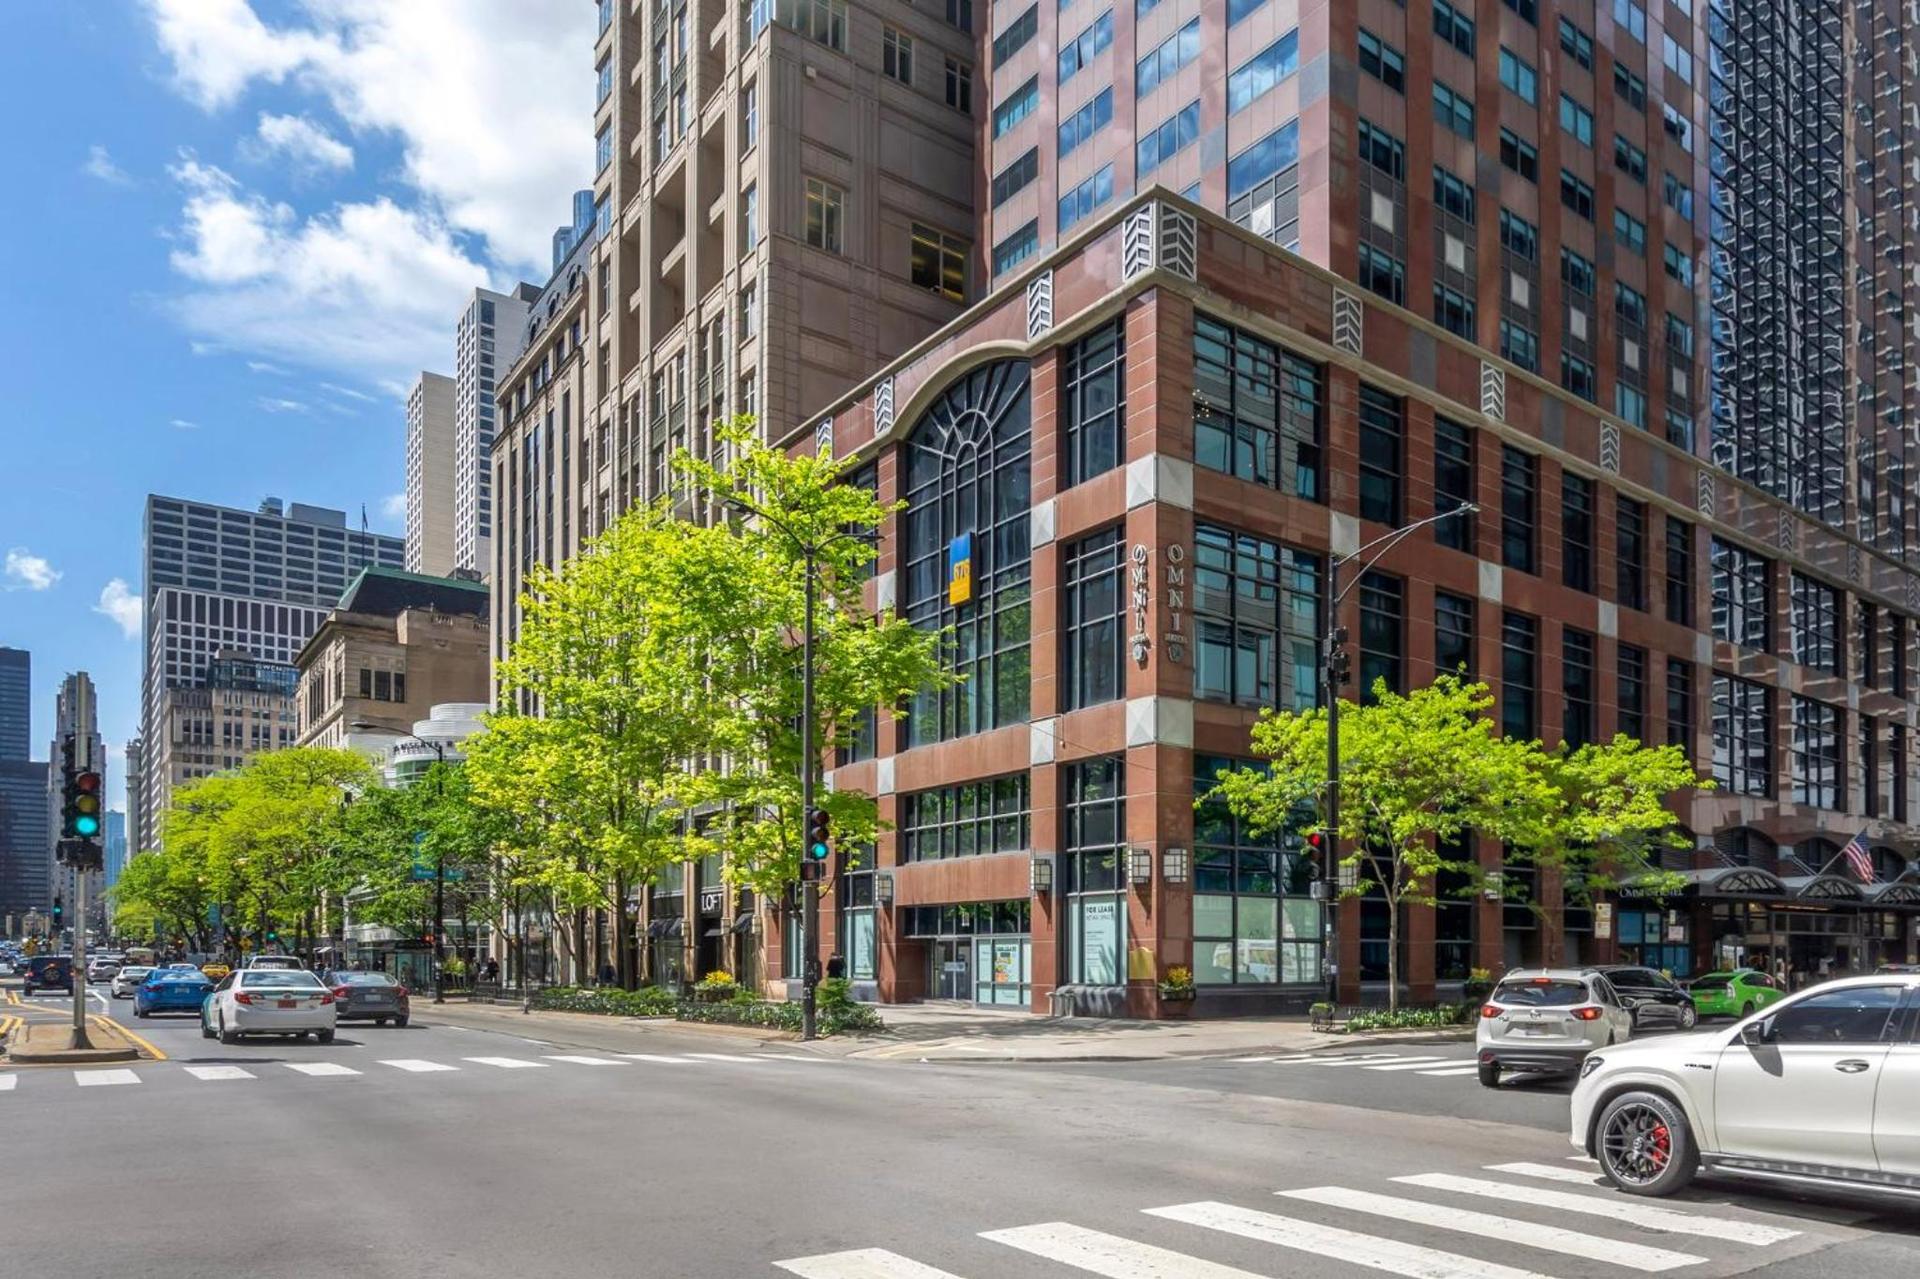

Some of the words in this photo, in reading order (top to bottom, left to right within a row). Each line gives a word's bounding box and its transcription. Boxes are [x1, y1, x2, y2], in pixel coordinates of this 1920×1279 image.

[1131, 544, 1148, 632] OMNI
[1167, 543, 1185, 631] OMNI
[701, 893, 723, 911] LOFT
[1098, 904, 1114, 913] LEASE
